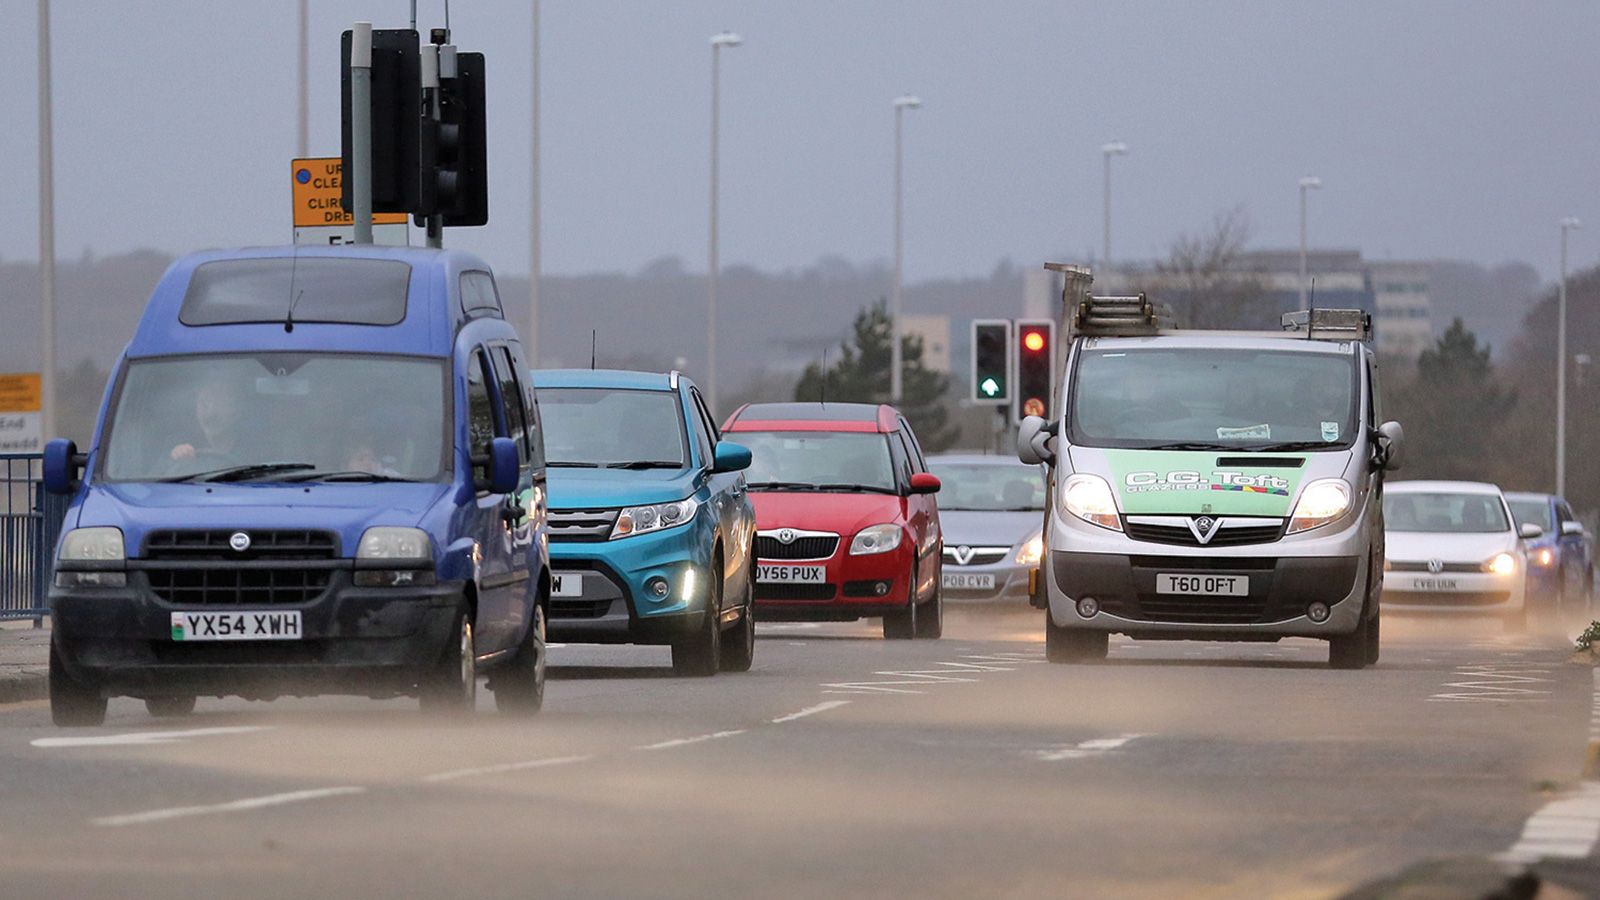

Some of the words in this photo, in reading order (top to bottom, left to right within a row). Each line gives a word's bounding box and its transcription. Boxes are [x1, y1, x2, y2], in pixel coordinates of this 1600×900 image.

[313, 178, 343, 189] CLE
[308, 198, 343, 209] CLIR
[1211, 471, 1289, 489] Toft
[792, 567, 819, 581] PUX
[967, 575, 990, 586] CVR
[1169, 576, 1200, 592] T60
[187, 615, 246, 636] YX54
[254, 614, 297, 635] XWH
